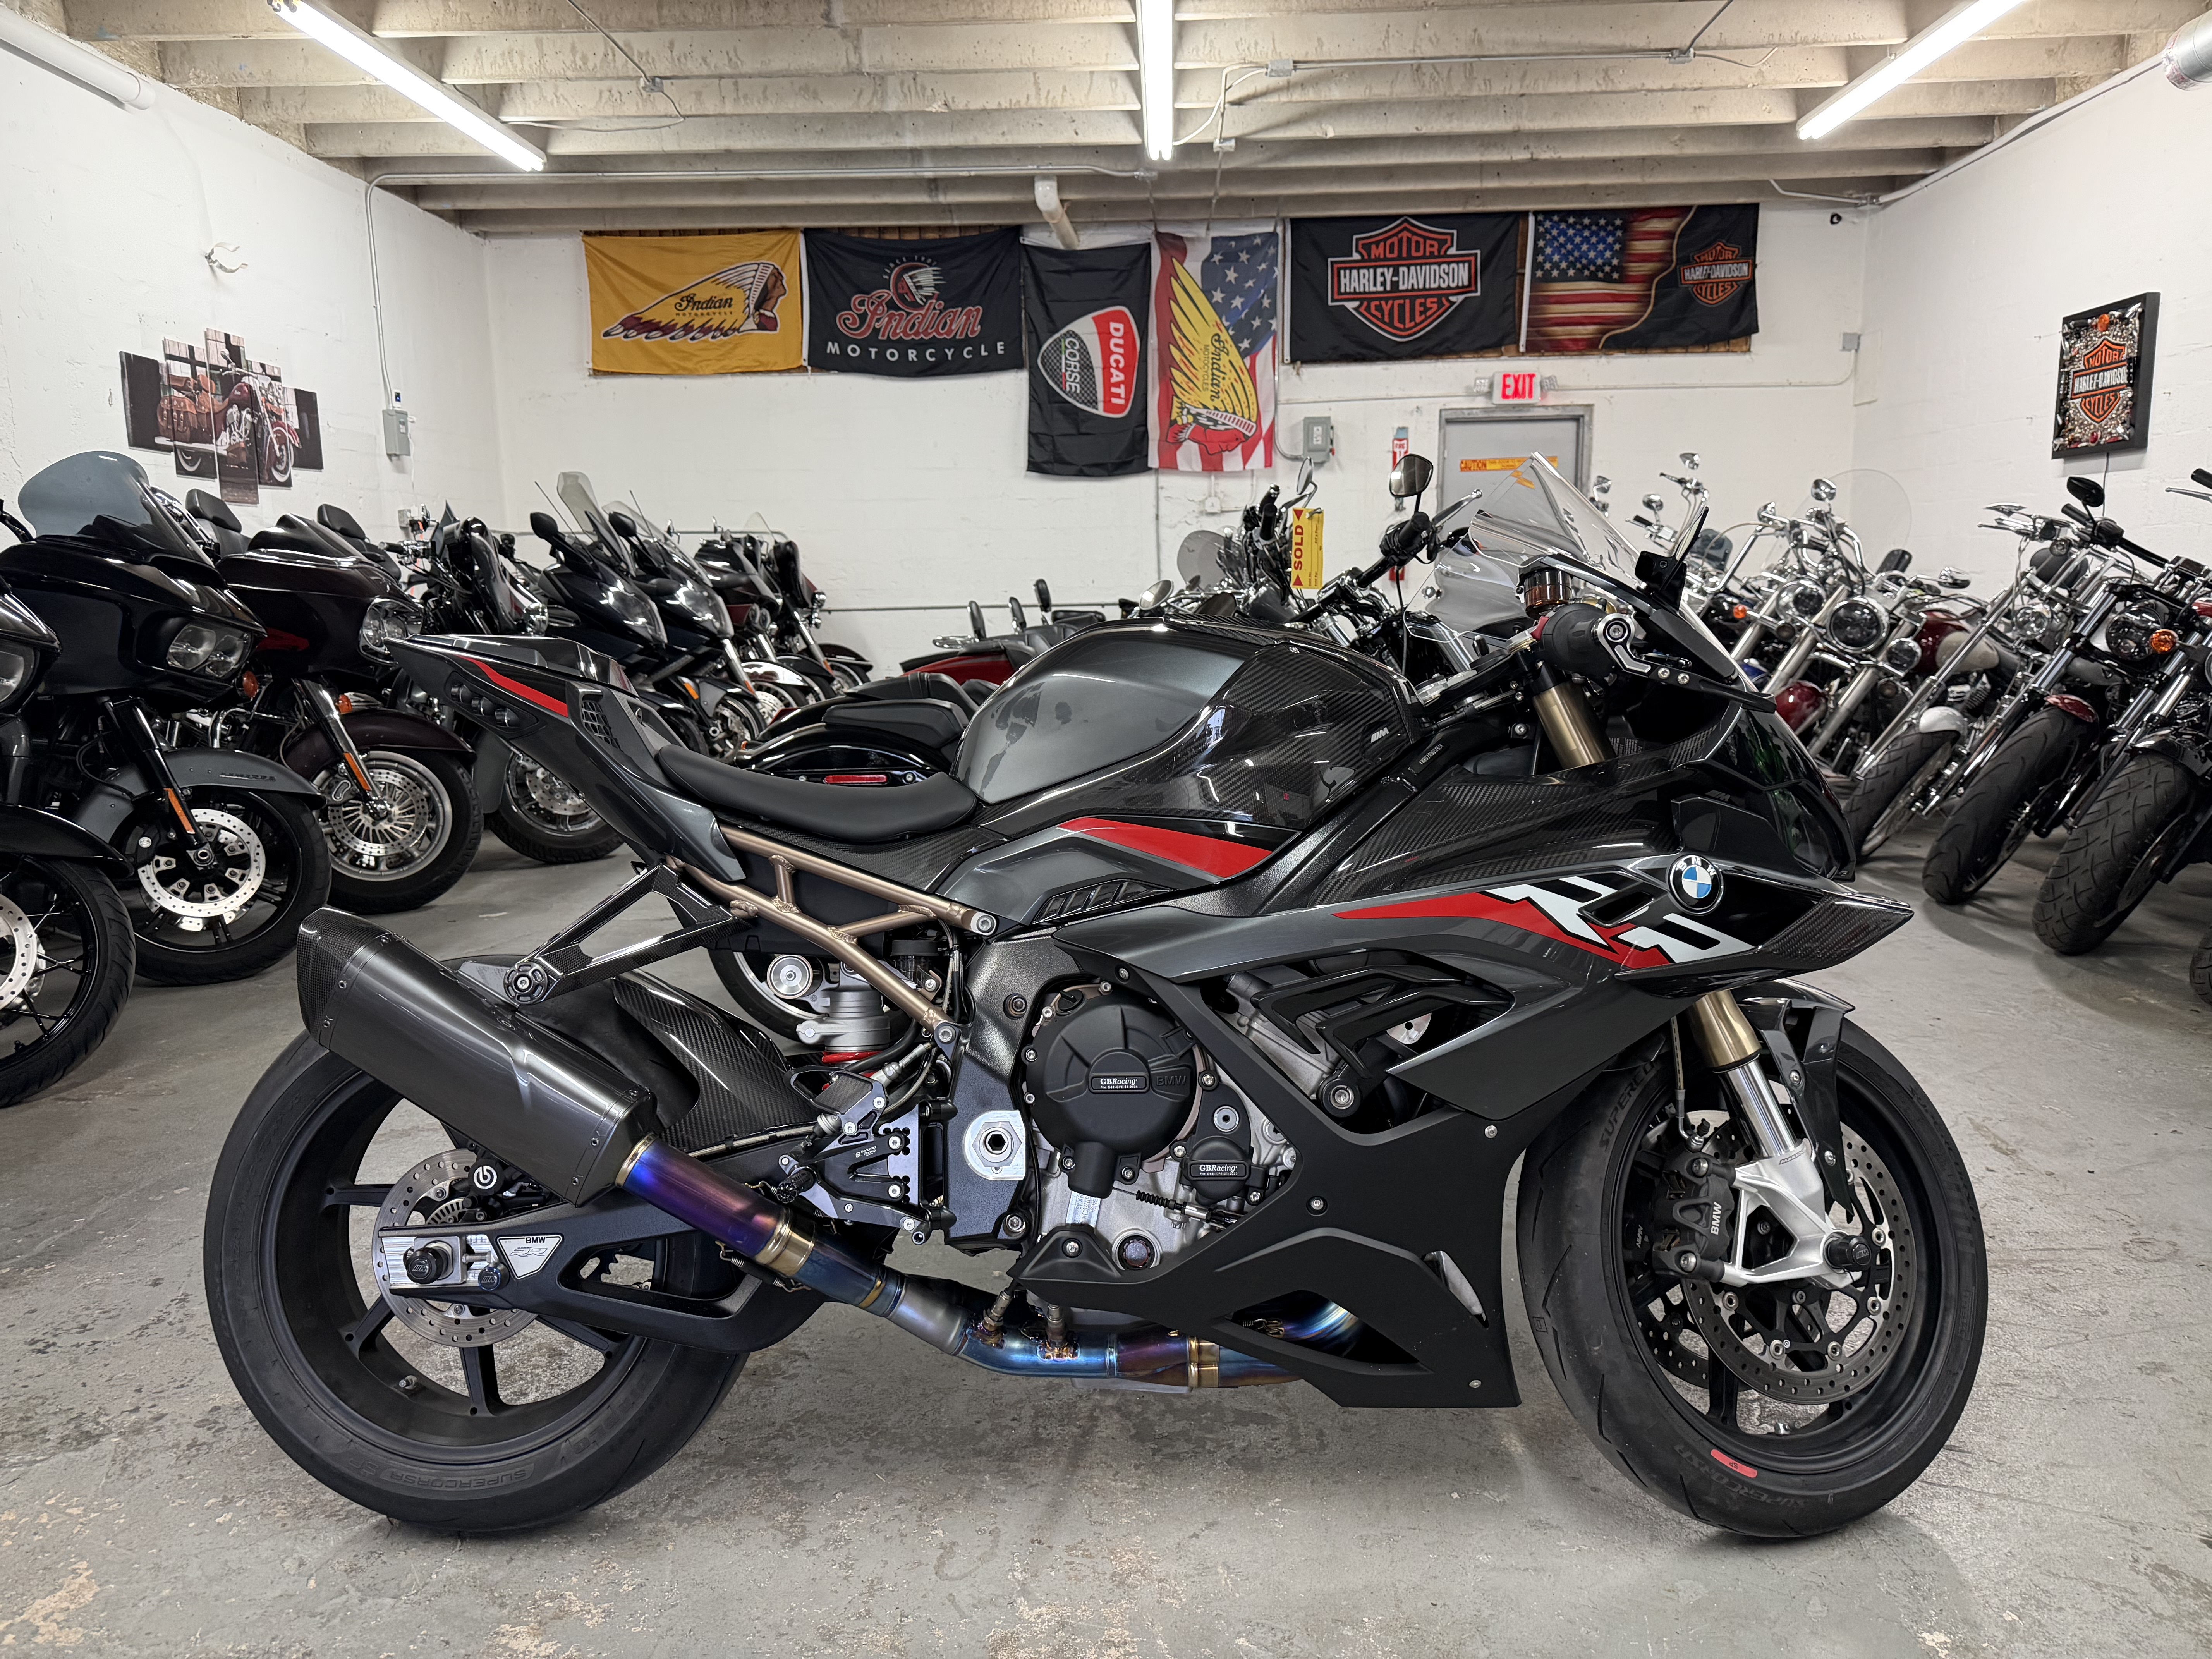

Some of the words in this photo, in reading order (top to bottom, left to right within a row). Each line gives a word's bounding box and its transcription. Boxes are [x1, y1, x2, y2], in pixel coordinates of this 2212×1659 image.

[1371, 231, 1439, 259] MOTOR
[1700, 246, 1733, 262] MOTOR
[1340, 262, 1469, 293] HARLEY-DAVIDSON
[1684, 262, 1748, 281] HARLEY-DAVIDSON
[675, 293, 733, 311] Indian
[1697, 282, 1732, 300] CYCLES
[836, 289, 983, 340] Indian
[1370, 298, 1438, 328] CYCLES
[826, 342, 1005, 362] MOTORCYCLE
[2089, 346, 2119, 368] MOTOR
[1065, 337, 1080, 394] CORSE
[1109, 322, 1125, 405] DUCATI
[1210, 333, 1230, 402] Indian
[1501, 373, 1537, 400] EXIT
[2086, 392, 2115, 416] CYCLES
[1293, 525, 1304, 571] SOLD
[1676, 857, 1717, 876] BMW
[1100, 1077, 1136, 1085] GBRacing
[1156, 1075, 1186, 1085] BMW
[1199, 1164, 1235, 1173] GBRacing
[1711, 1202, 1722, 1235] BMW
[1729, 1461, 1738, 1470] SP
[390, 1469, 527, 1488] SUPERCORSA
